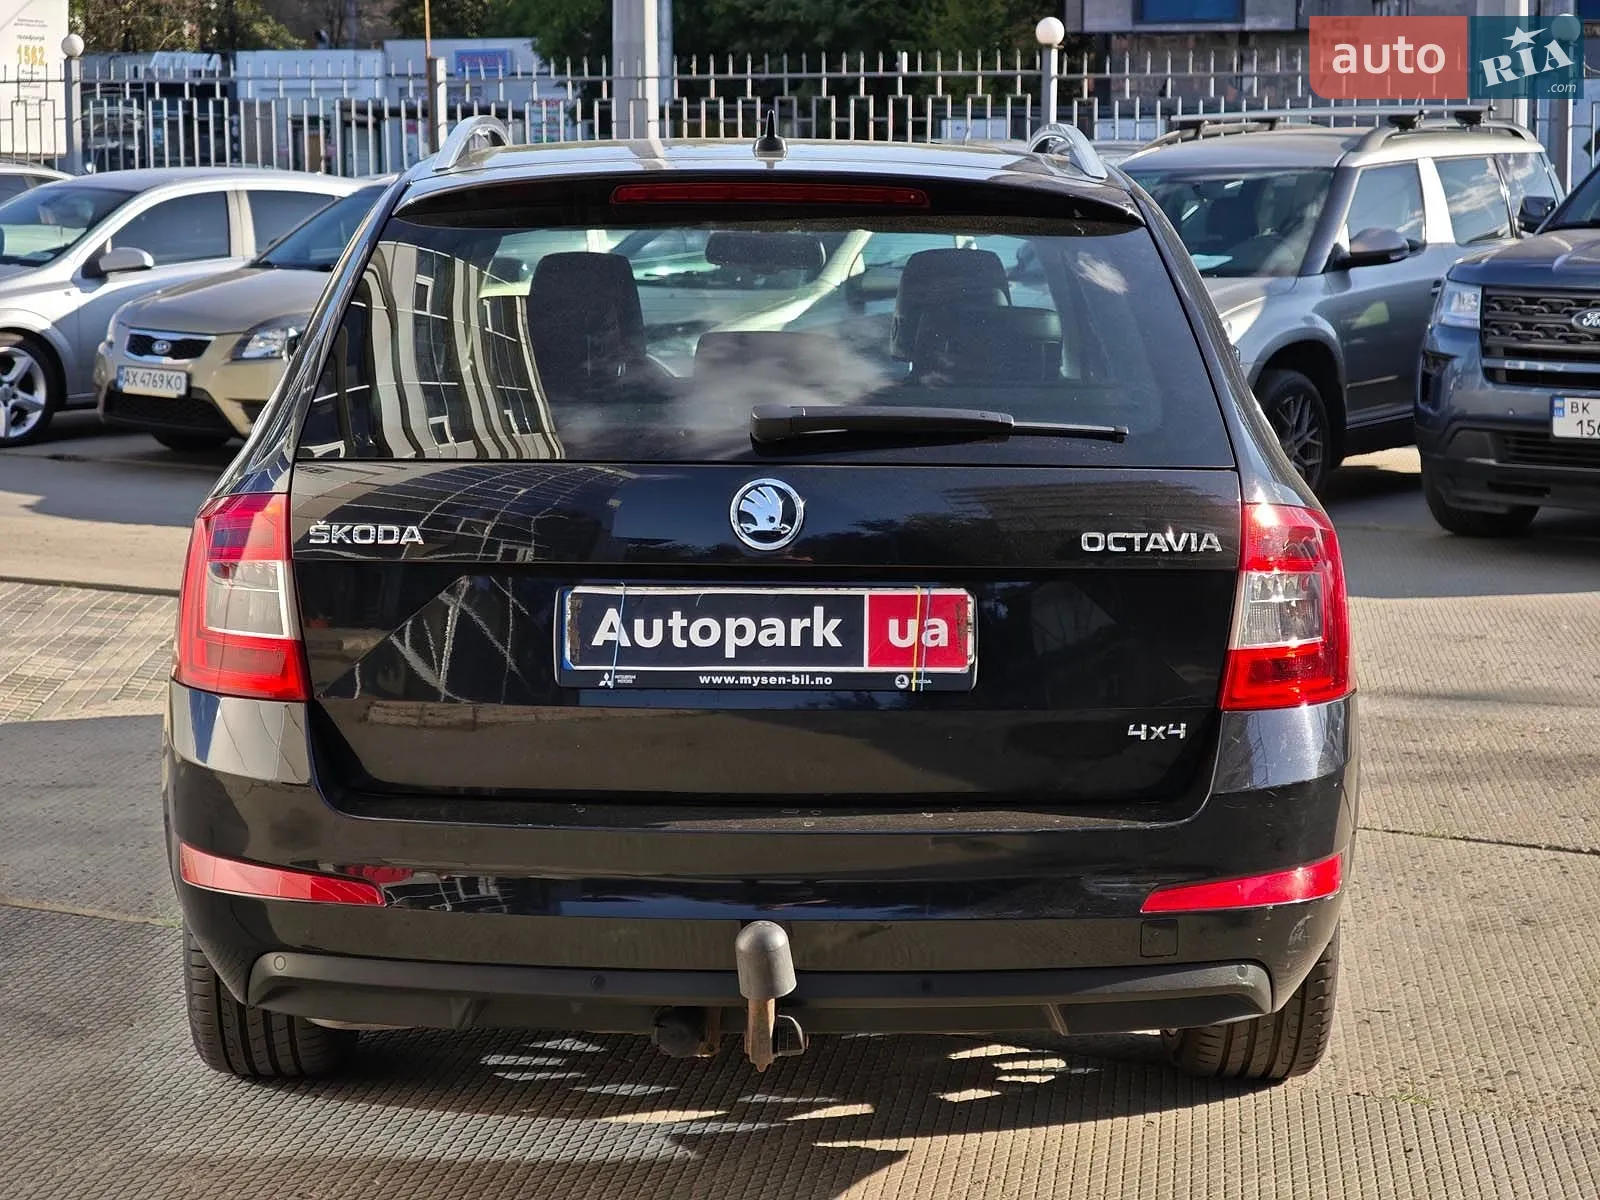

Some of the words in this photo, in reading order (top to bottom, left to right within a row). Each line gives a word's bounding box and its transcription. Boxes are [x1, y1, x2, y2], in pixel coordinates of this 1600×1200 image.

[1570, 402, 1590, 414] BK
[309, 520, 424, 545] ŠKODA
[1081, 531, 1223, 553] OCTAVIA
[591, 605, 843, 659] Autopark
[888, 617, 948, 648] ua
[699, 674, 833, 687] www.mysen-bil.no
[1128, 723, 1186, 741] 4x4
